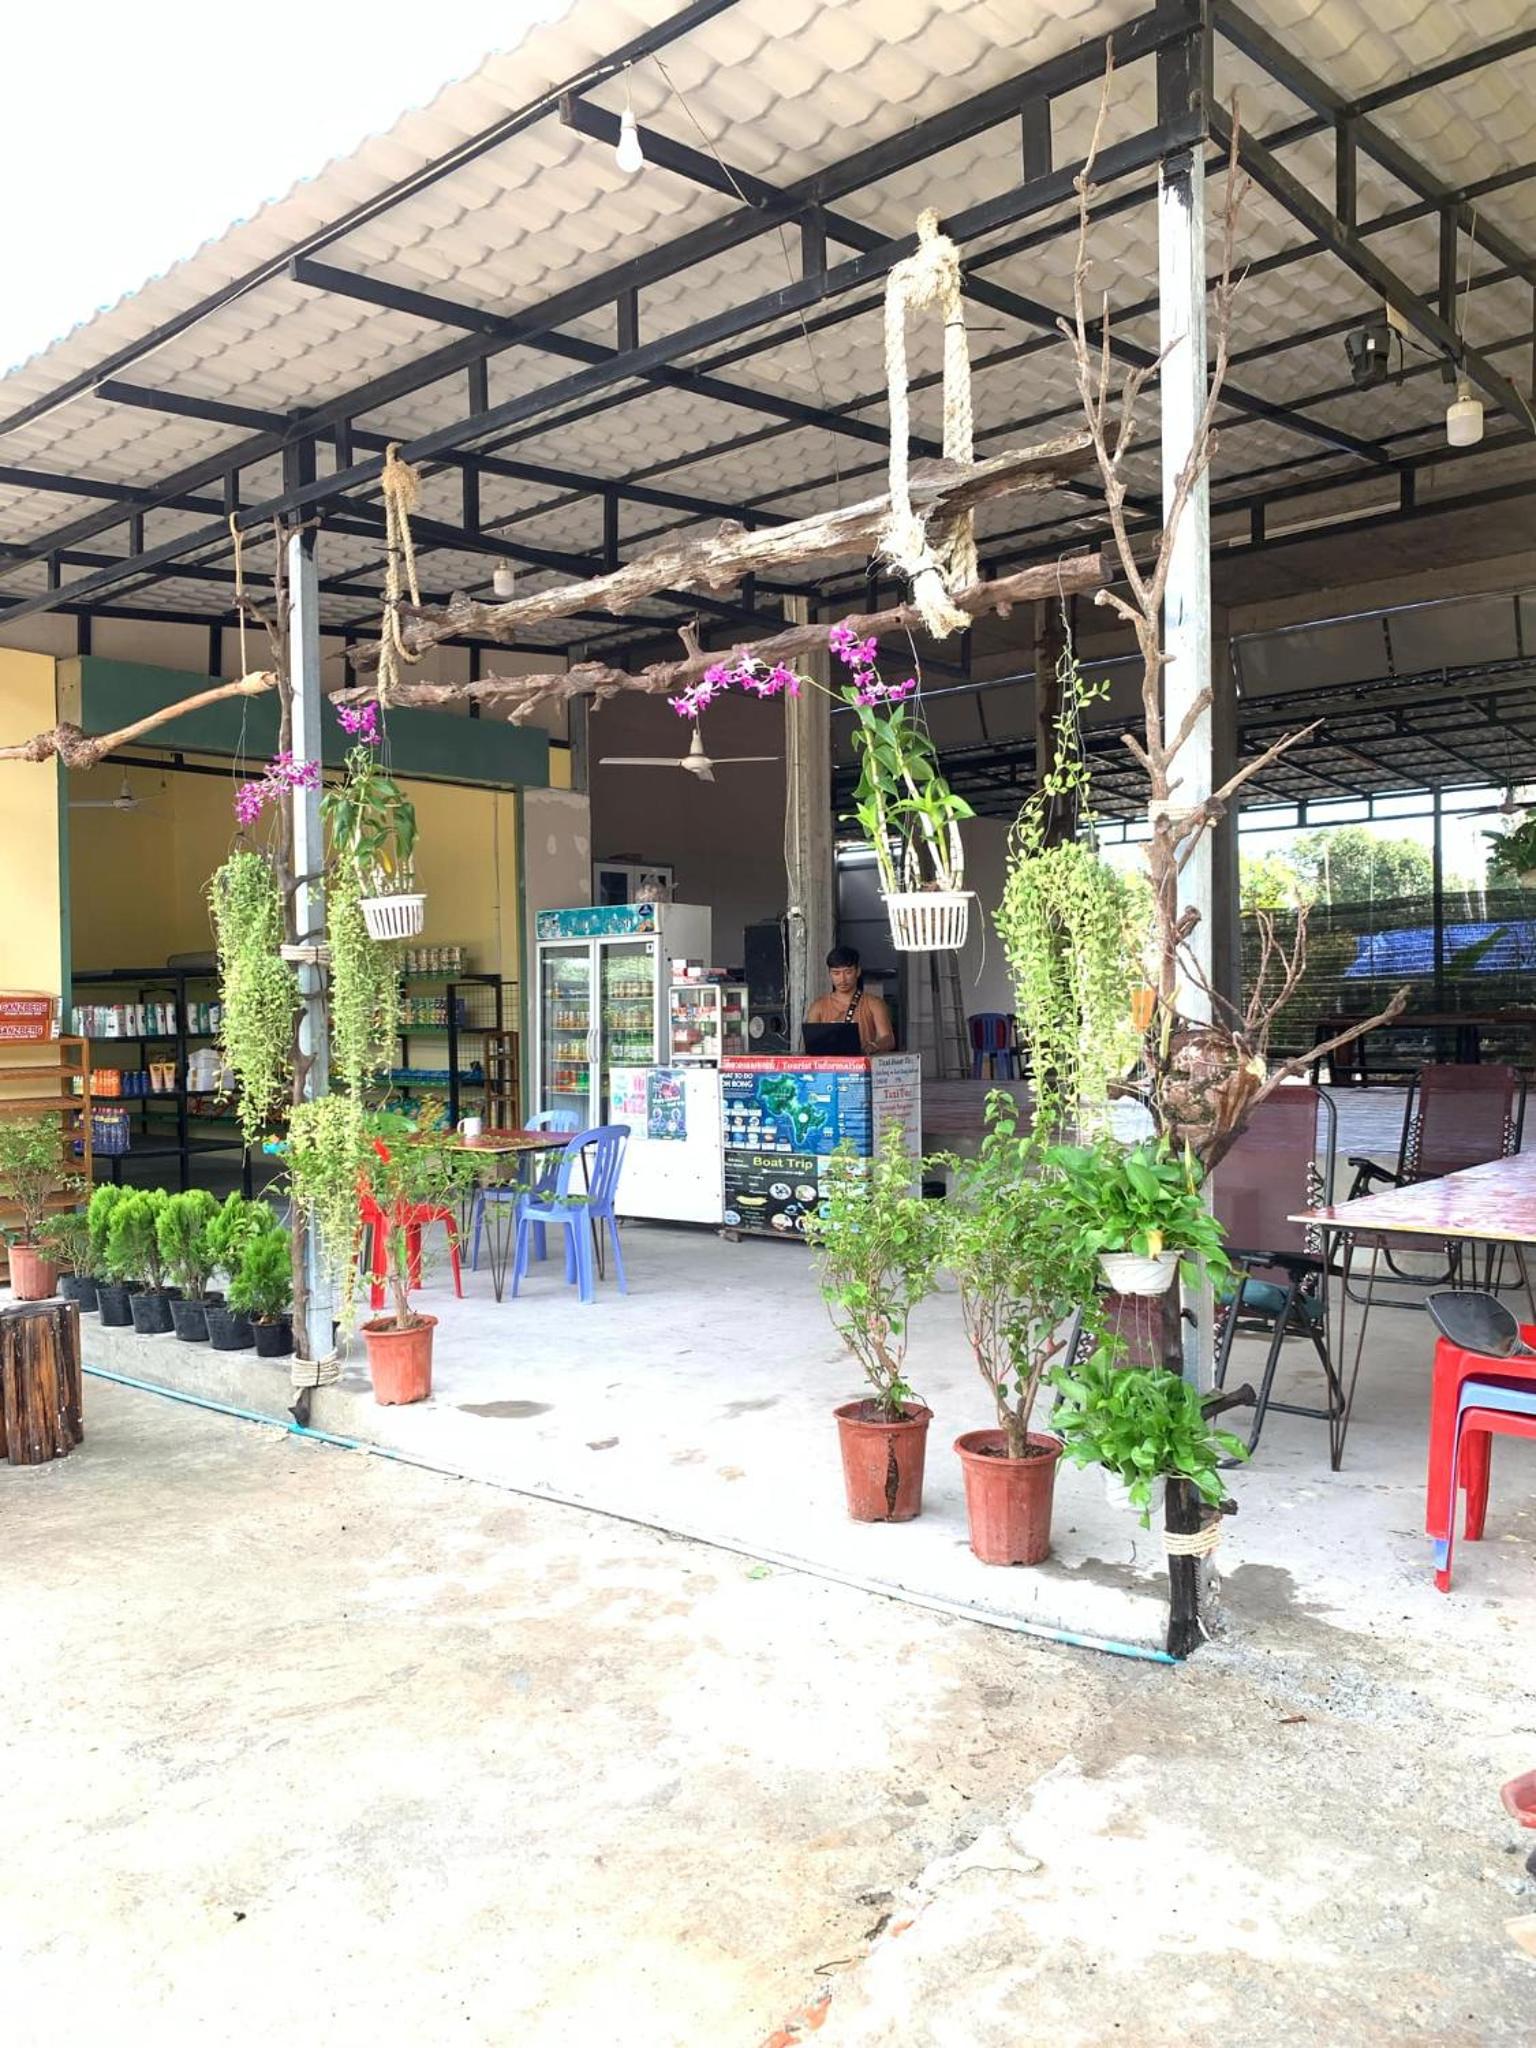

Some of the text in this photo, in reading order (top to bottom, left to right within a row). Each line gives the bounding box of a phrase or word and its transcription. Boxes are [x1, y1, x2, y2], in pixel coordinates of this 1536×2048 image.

[783, 1061, 812, 1070] Tourist
[814, 1060, 867, 1070] Information
[753, 1156, 784, 1168] Boat
[786, 1158, 813, 1171] Trip
